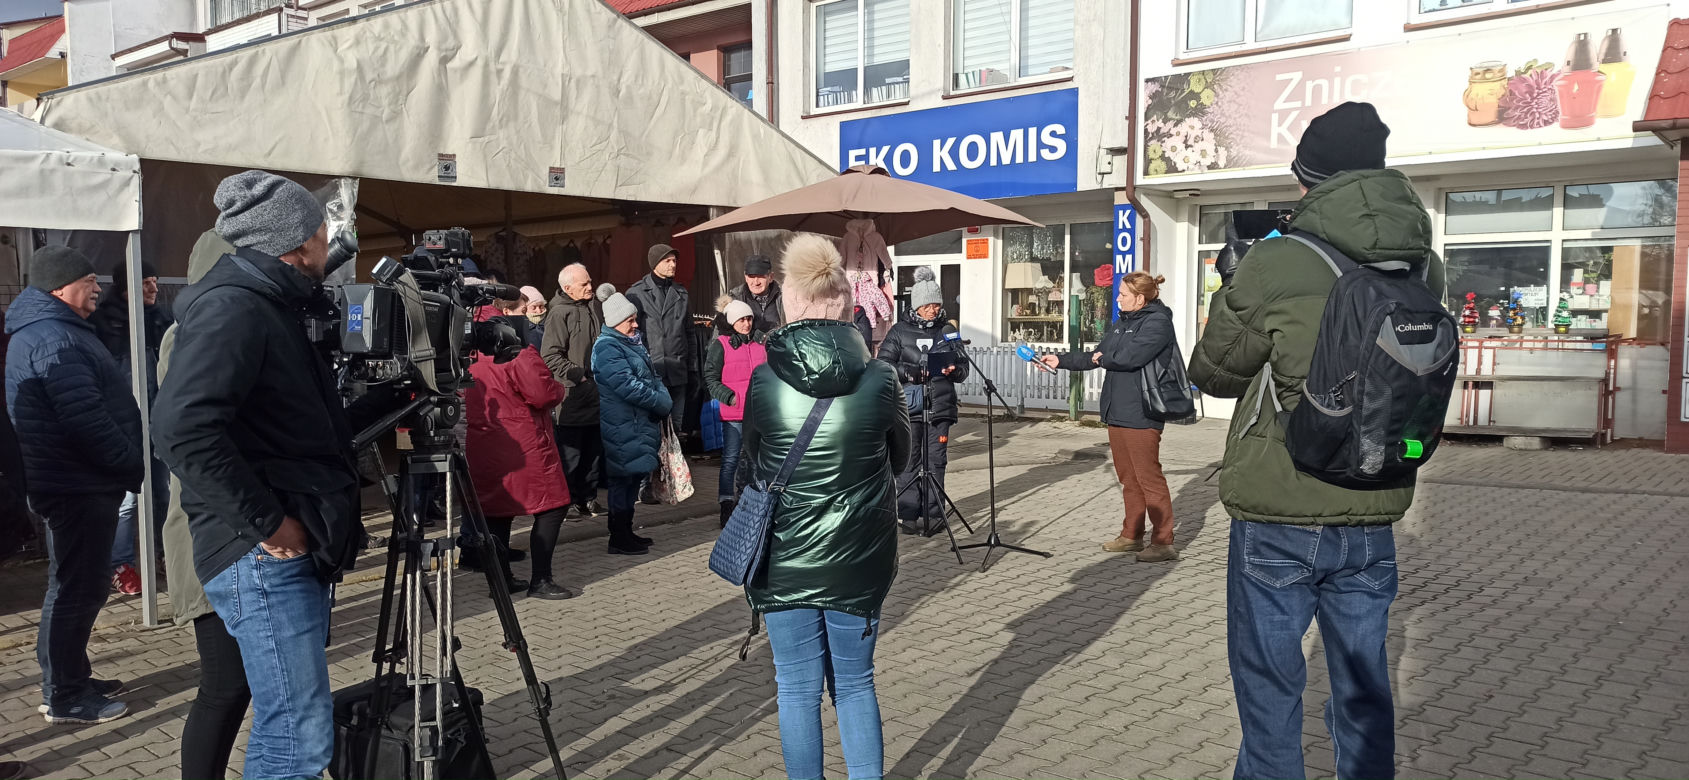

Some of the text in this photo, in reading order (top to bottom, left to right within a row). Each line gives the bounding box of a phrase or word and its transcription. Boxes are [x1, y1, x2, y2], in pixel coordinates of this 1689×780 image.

[1273, 65, 1397, 111] Znicz
[848, 123, 1068, 177] EKO KOMIS
[1397, 322, 1433, 333] Columbia
